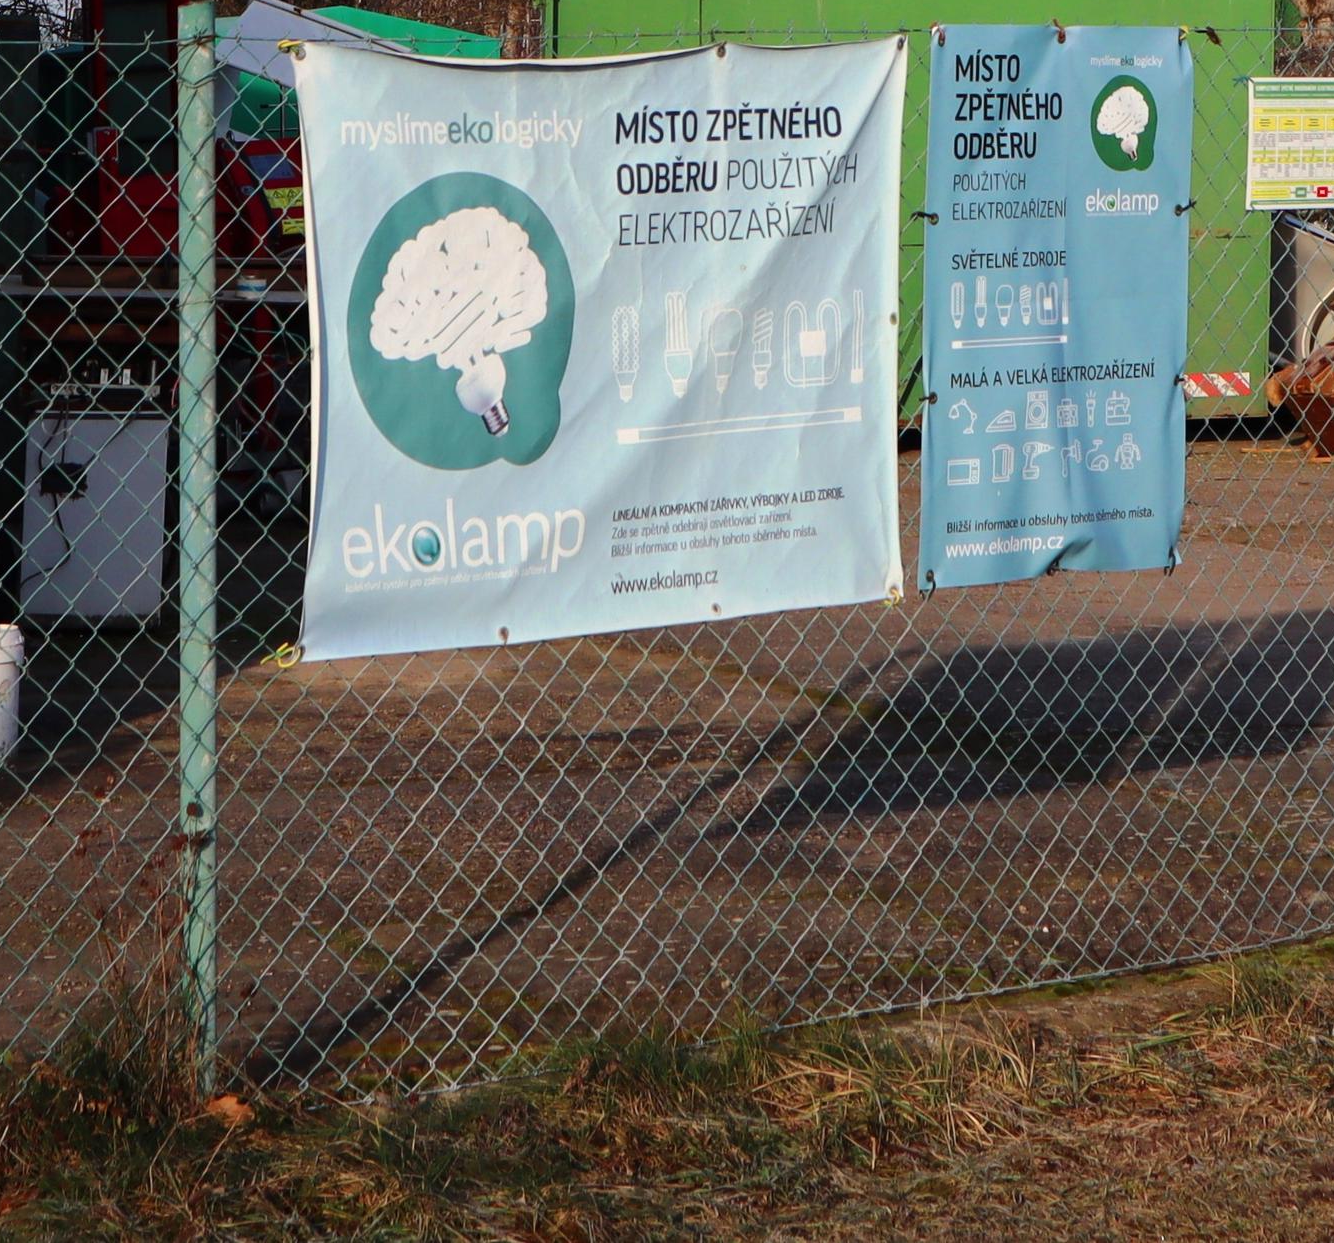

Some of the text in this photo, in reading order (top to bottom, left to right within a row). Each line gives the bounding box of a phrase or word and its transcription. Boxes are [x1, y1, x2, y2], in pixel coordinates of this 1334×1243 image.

[955, 49, 1020, 82] MÍSTO
[1090, 55, 1164, 68] myslímeekologicky
[954, 88, 1063, 121] ZPĚTNÉHO
[340, 109, 583, 151] myslímeekologicky
[615, 101, 842, 145] MÍSTO ZPĚTNÉHO
[953, 127, 1037, 160] ODBĚRU
[617, 150, 858, 195] ODBĚRU POUŽITÝCH
[953, 169, 1027, 192] POUŽITÝCH
[952, 196, 1067, 221] ELEKTROZAŘÍZENÍ
[1085, 187, 1159, 215] ekolamp
[619, 197, 837, 246] ELEKTROZAŘÍZENÍ
[951, 247, 1067, 270] SVĚTELNÉ ZDROJE
[950, 357, 1156, 389] MALÁ A VELKÁ ELEKTROZAŘÍZENÍ
[650, 506, 658, 518] A
[659, 499, 708, 516] KOMPAKTNÍ
[710, 497, 749, 511] ZÁŘIVKY,
[751, 493, 789, 507] VÝBOJKY
[791, 492, 798, 503] A
[800, 490, 816, 503] LED
[612, 526, 627, 539] Zde
[629, 529, 638, 538] se
[946, 519, 971, 534] Bližší
[974, 517, 1018, 532] informace
[1020, 519, 1026, 527] u
[1028, 513, 1068, 529] obsluhy
[1128, 506, 1155, 519] místa.
[342, 498, 586, 579] ekolamp
[635, 539, 678, 555] informace
[680, 541, 687, 550] u
[689, 534, 720, 549] obsluhy
[722, 532, 751, 545] tohoto
[753, 528, 790, 542] sběrného
[945, 535, 1065, 559] www.ekolamp.cz
[611, 568, 719, 595] www.ekolamp.cz
